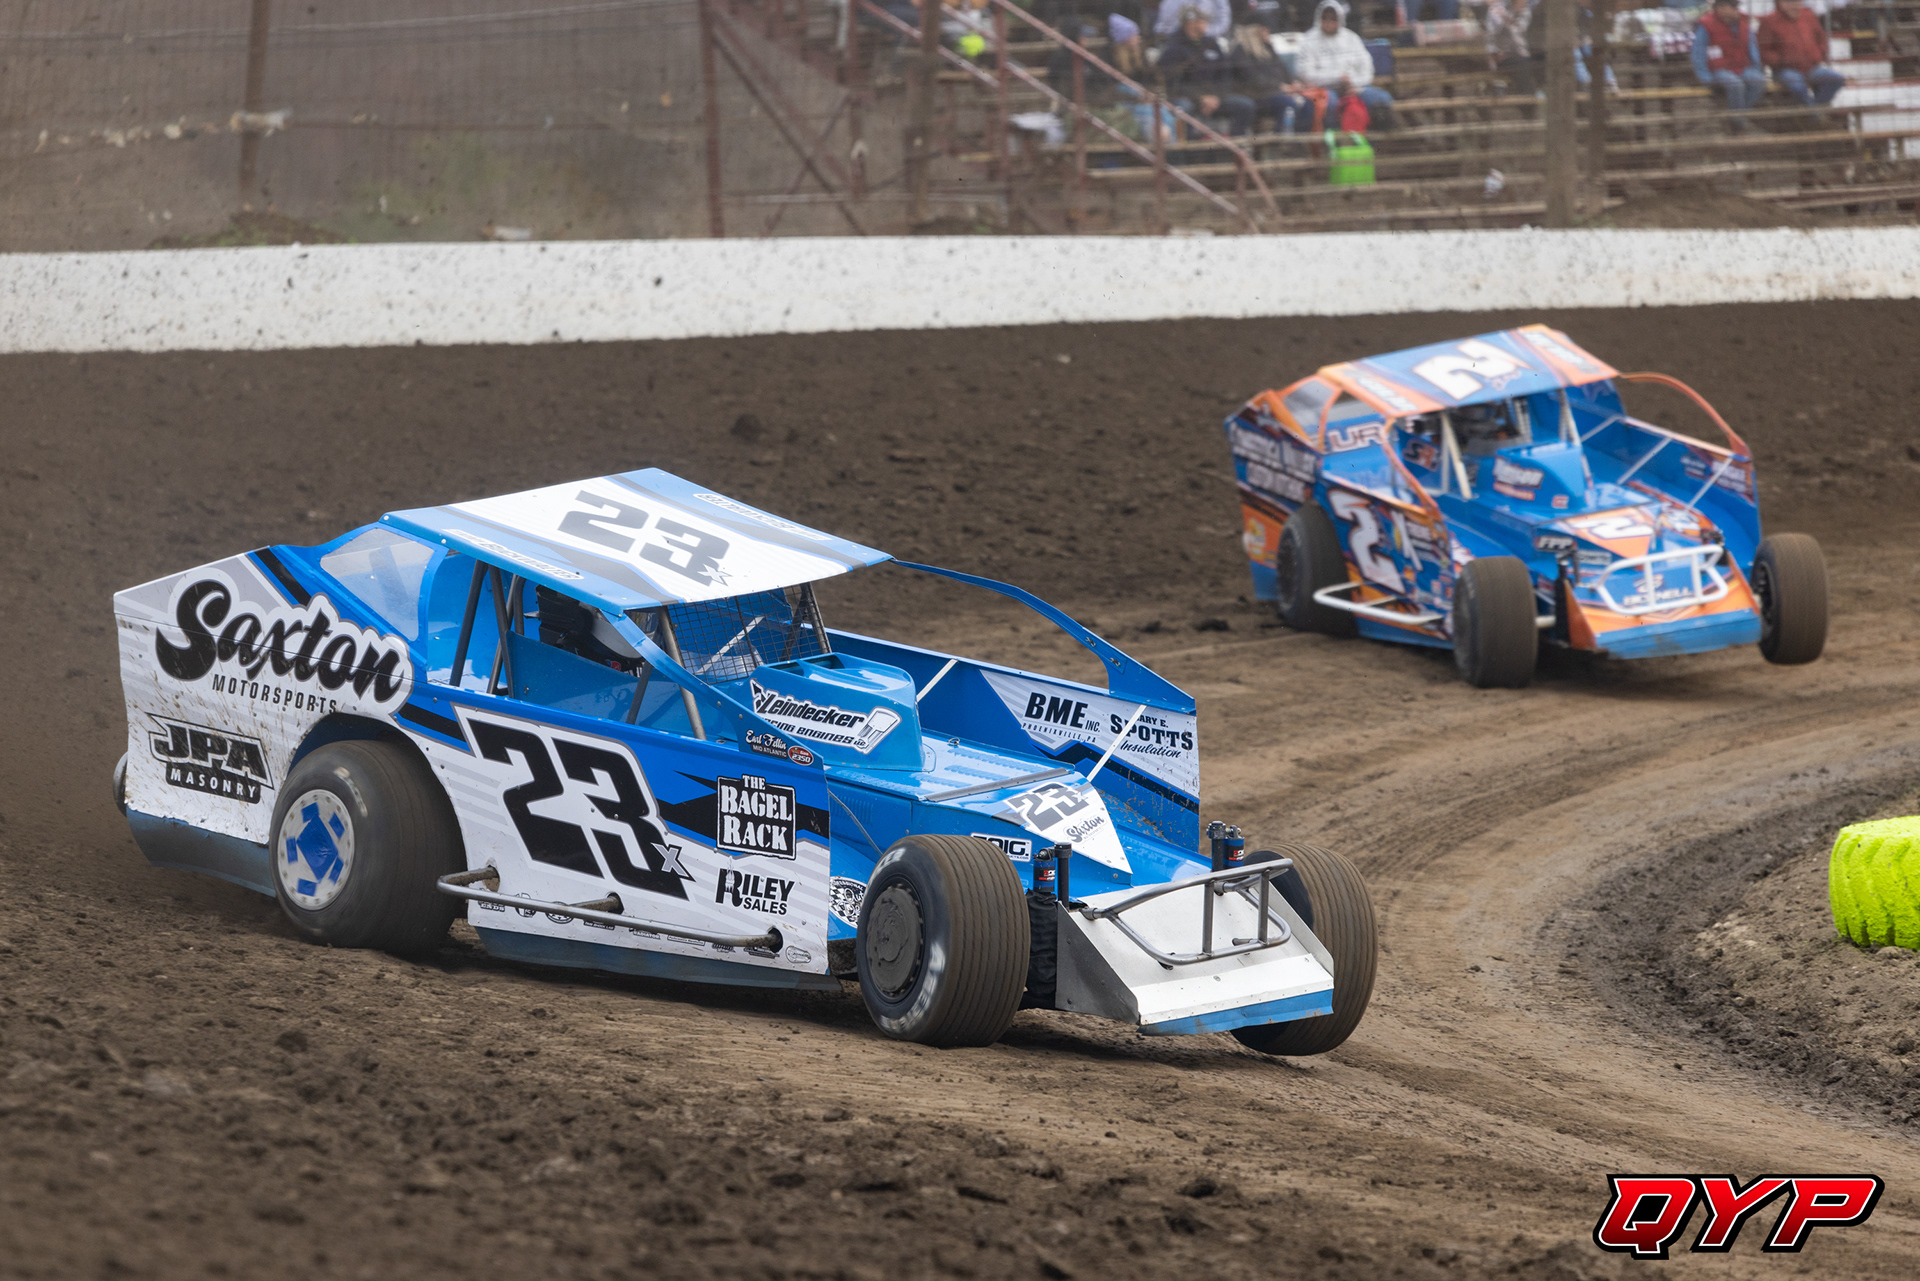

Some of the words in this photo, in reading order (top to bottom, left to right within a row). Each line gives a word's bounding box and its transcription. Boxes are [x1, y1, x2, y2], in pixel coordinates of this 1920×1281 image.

[1328, 490, 1405, 594] 2
[155, 579, 404, 703] Saxton
[212, 674, 338, 713] MOTORSPORTS
[757, 692, 865, 728] Leindecker
[1025, 692, 1088, 728] BME
[1085, 720, 1101, 733] INC.
[1138, 715, 1157, 725] ARY
[153, 723, 268, 781] JPA
[763, 748, 787, 757] ATLANTIC
[792, 753, 811, 763] 2350
[1120, 740, 1182, 758] Insulation
[170, 767, 257, 798] MASONRY
[742, 775, 765, 790] THE
[721, 785, 792, 821] BAGEL
[723, 816, 787, 850] RACK
[1066, 816, 1105, 842] Saxton
[715, 868, 795, 907] RILEY
[743, 897, 787, 915] SALES
